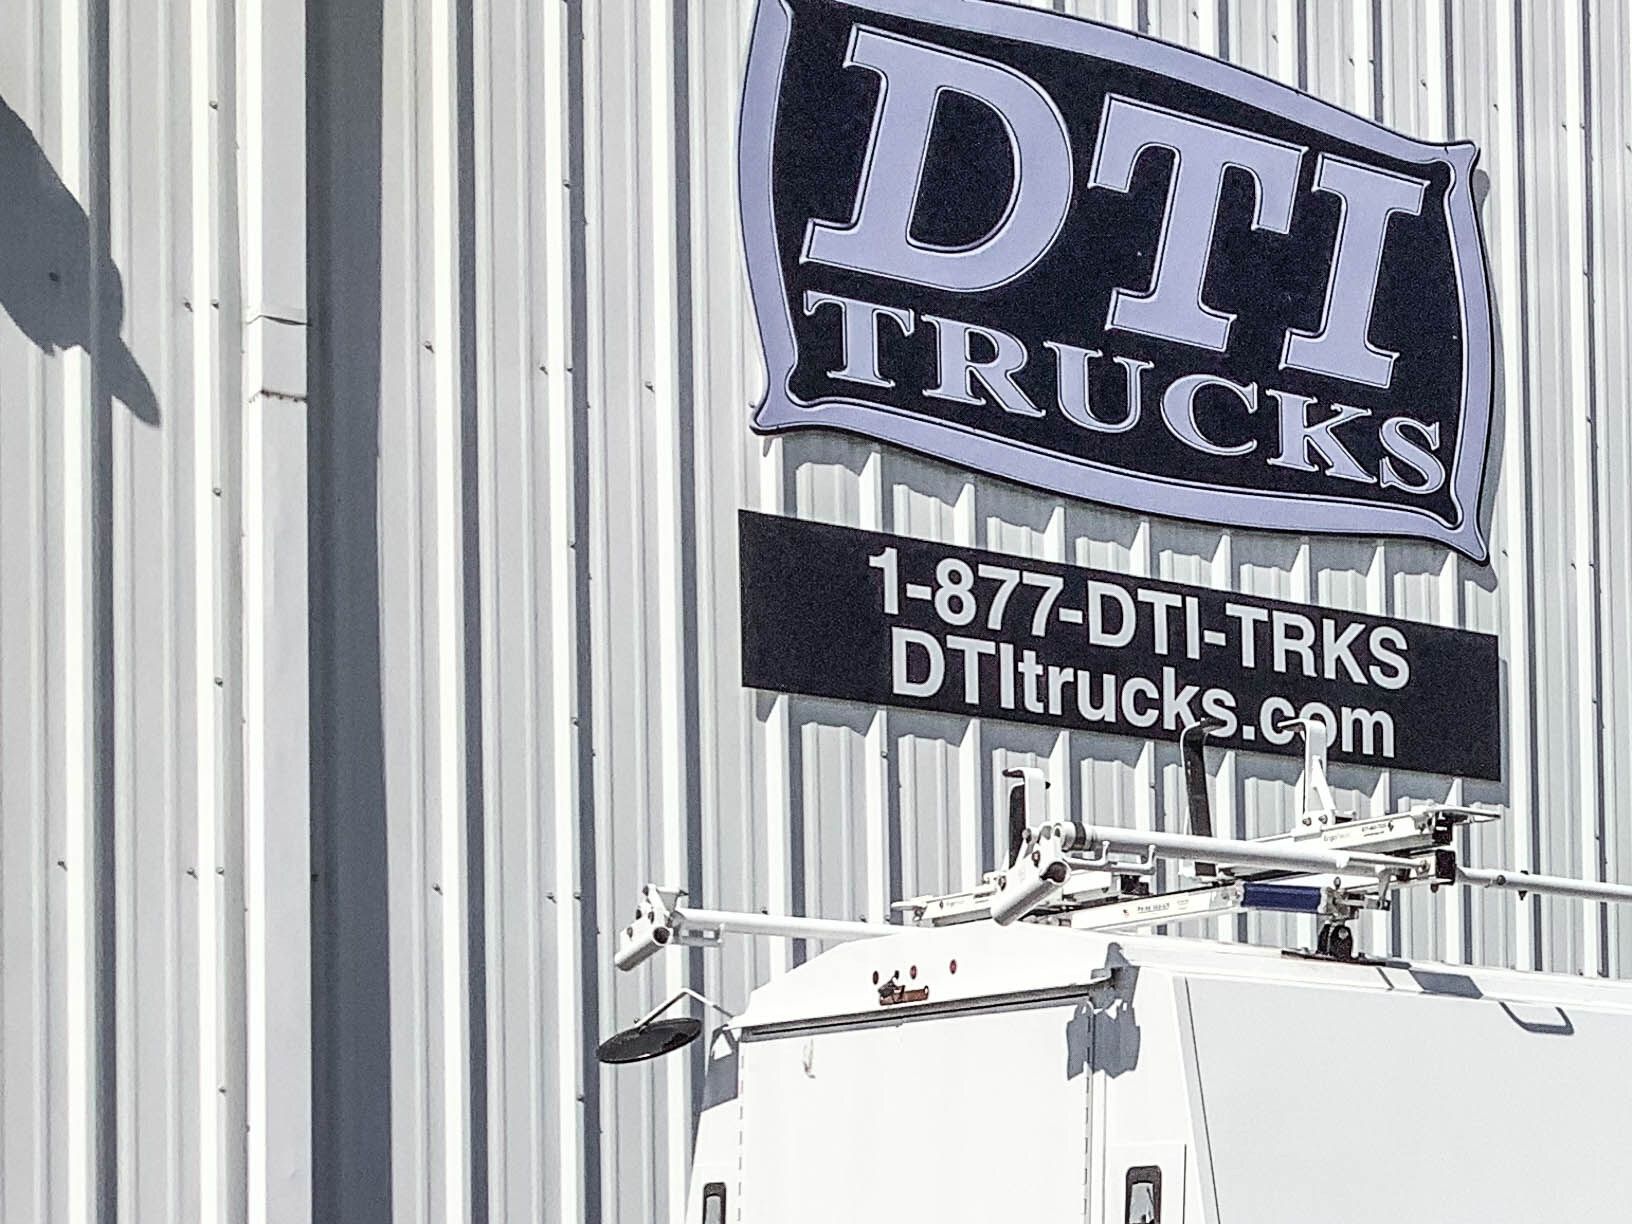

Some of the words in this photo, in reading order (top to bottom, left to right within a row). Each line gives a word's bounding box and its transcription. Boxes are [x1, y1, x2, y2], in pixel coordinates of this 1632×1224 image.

[800, 24, 1431, 389] DTI
[802, 289, 1447, 498] TRUCKS
[869, 548, 1411, 690] 1-877-DTI-TRKS
[891, 627, 1397, 759] DTItrucks.com
